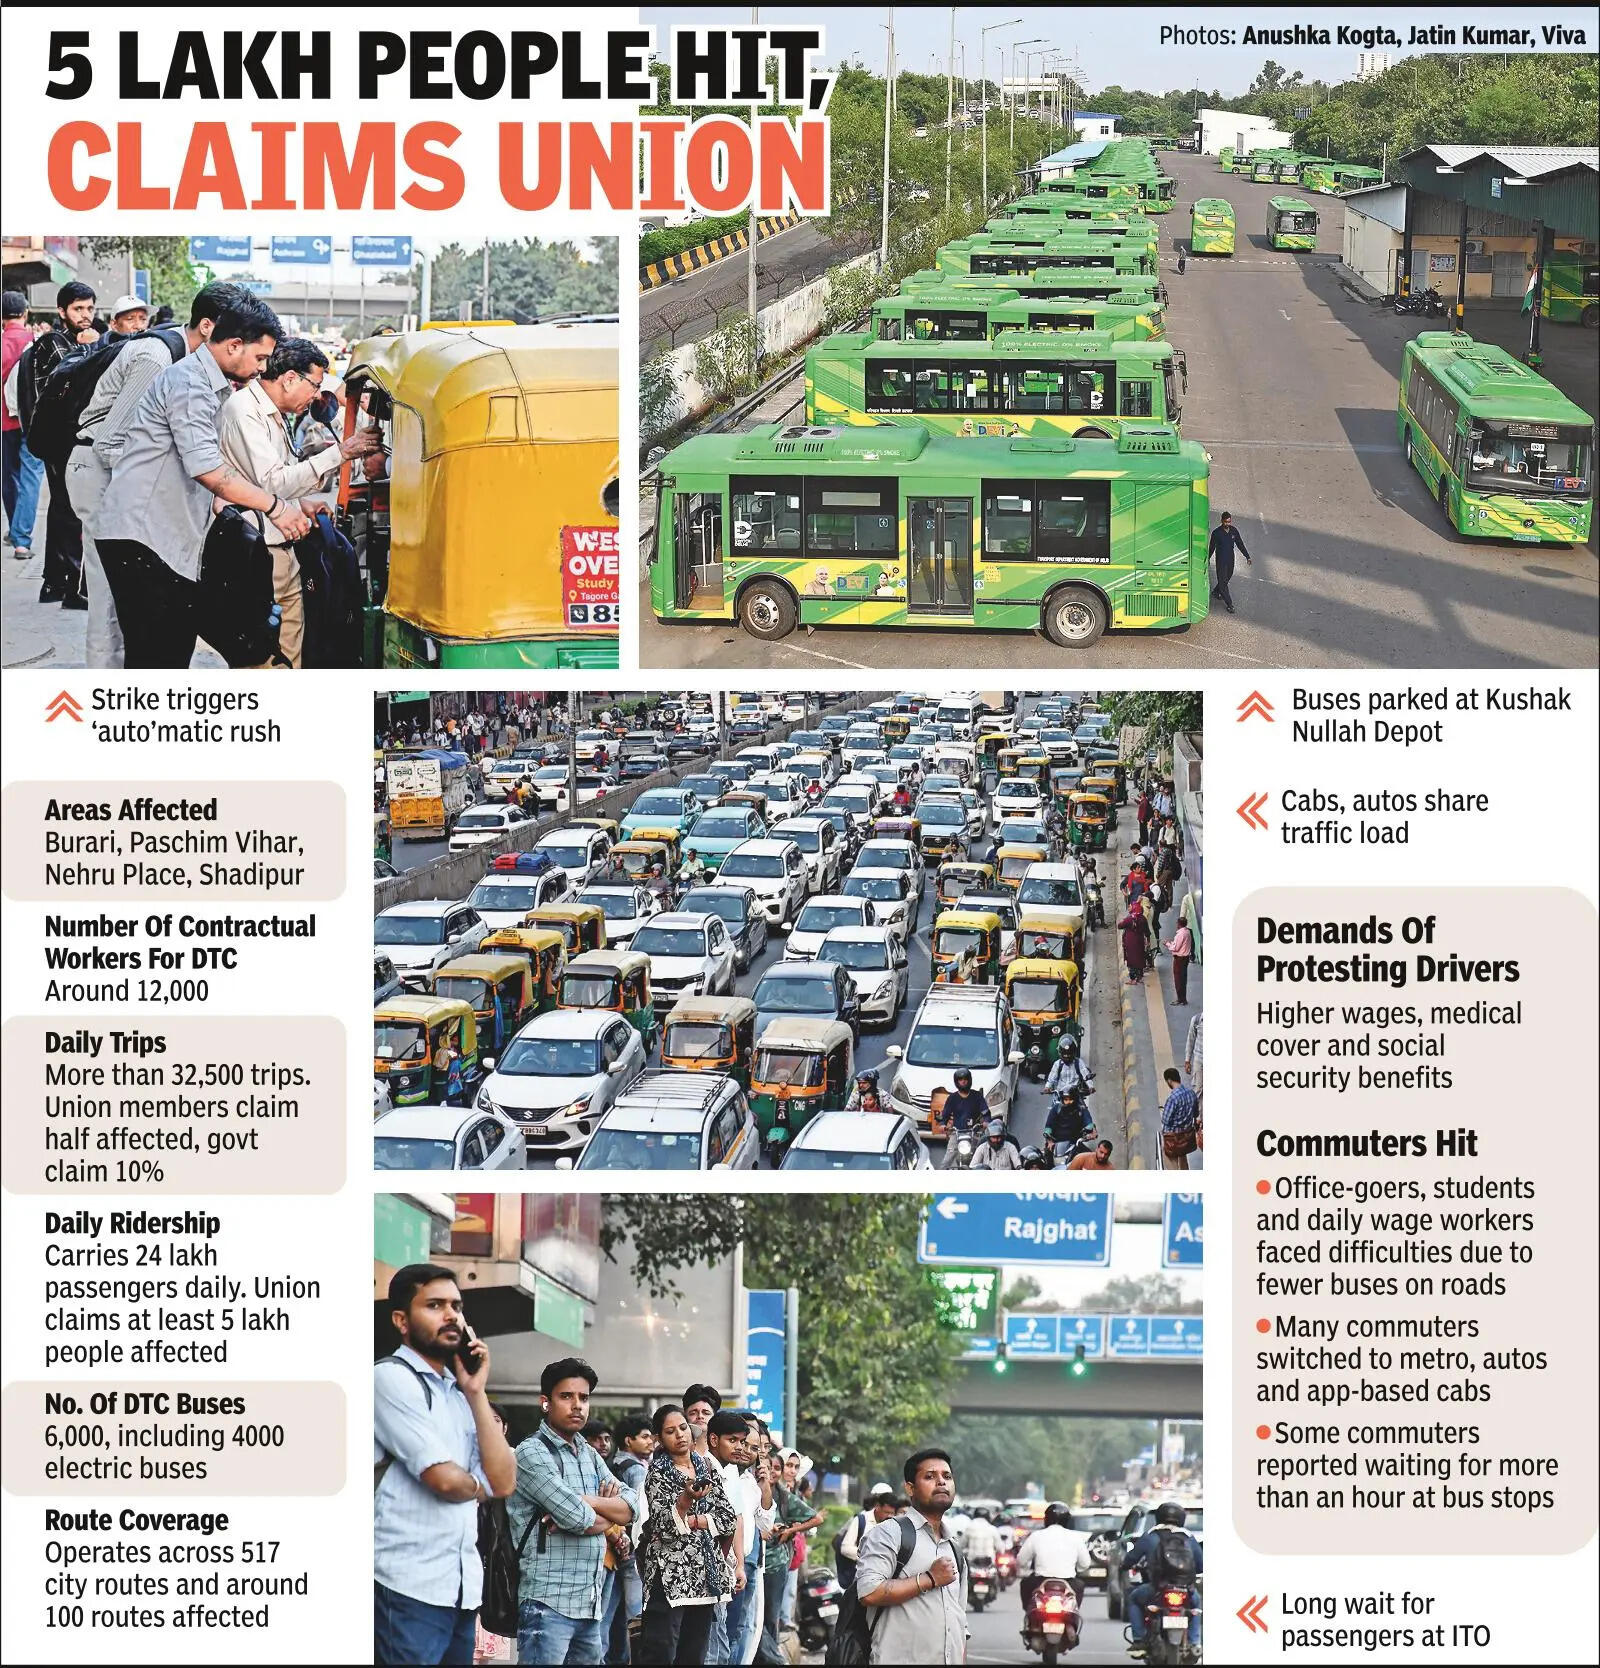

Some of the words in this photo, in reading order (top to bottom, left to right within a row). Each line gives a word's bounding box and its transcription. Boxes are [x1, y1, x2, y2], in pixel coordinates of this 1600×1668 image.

[576, 578, 614, 589] Study
[581, 592, 608, 602] Tagore
[1003, 1216, 1098, 1244] Rajghat
